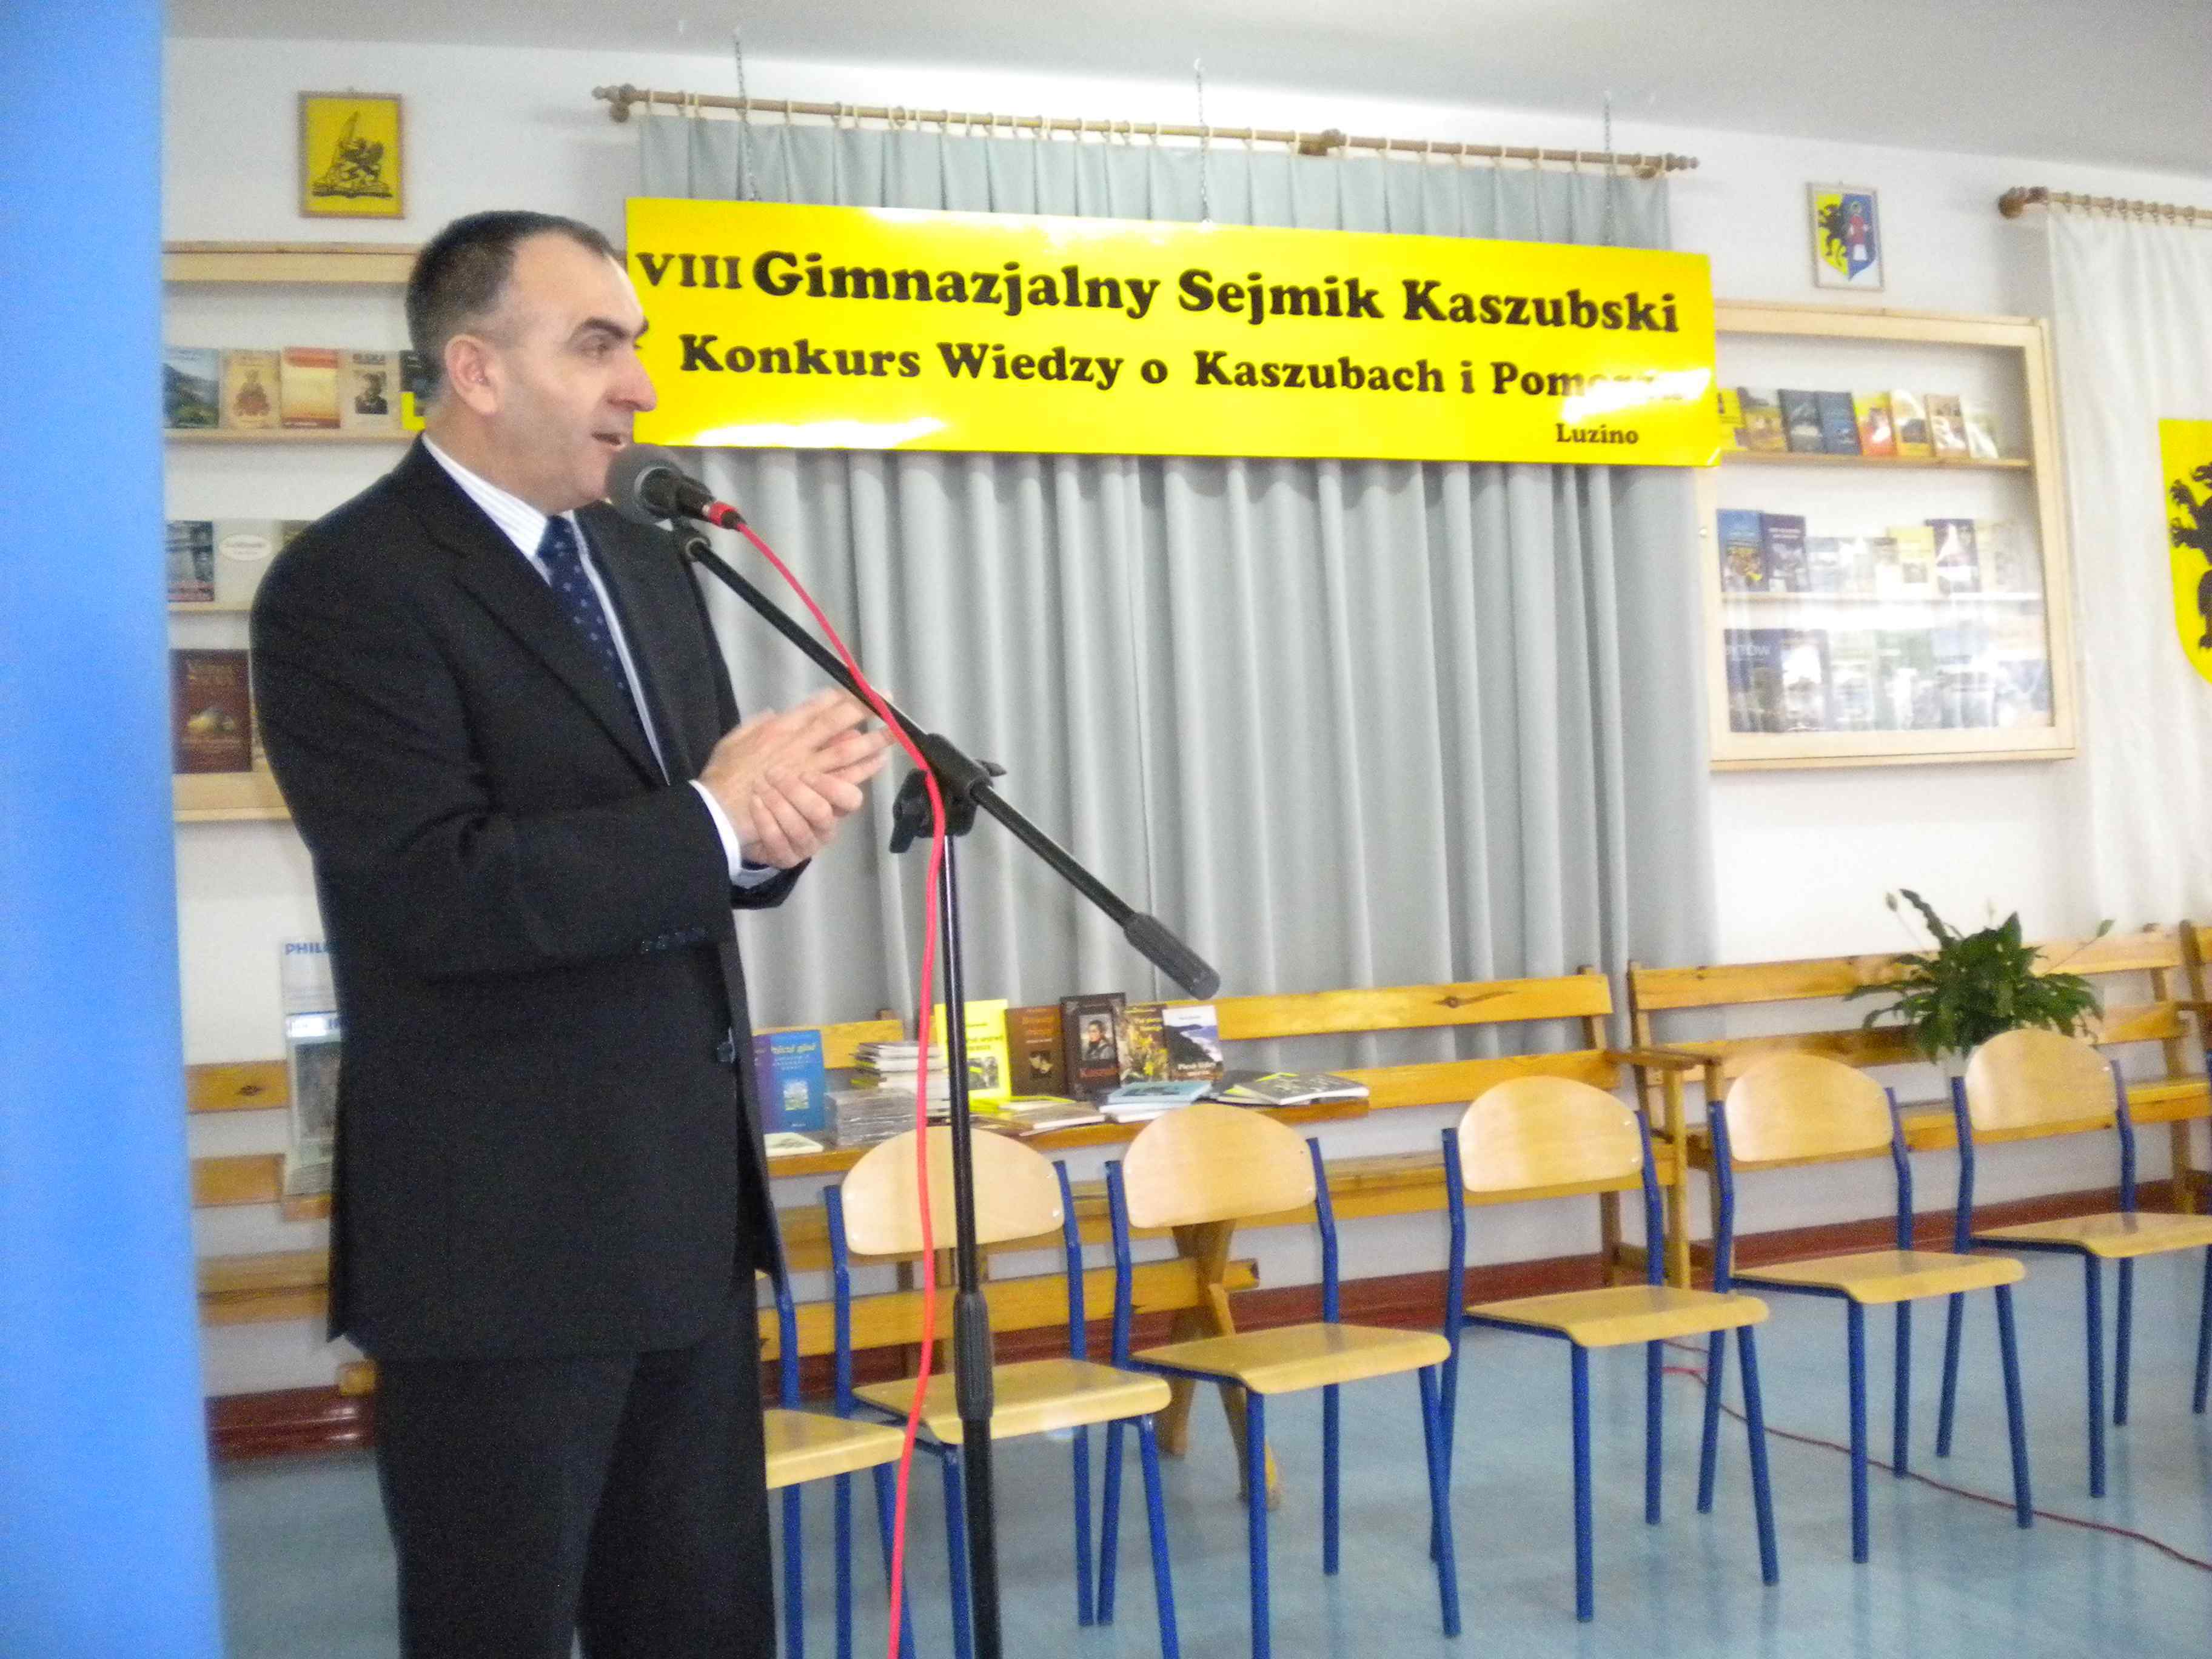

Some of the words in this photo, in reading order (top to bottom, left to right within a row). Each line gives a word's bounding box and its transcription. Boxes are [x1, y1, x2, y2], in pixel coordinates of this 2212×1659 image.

[635, 252, 742, 290] VIII
[753, 250, 1161, 320] Gimnazjalny
[1178, 269, 1385, 326] Sejmik
[1402, 280, 1679, 333] Kaszubski
[679, 333, 920, 377] Konkurs
[937, 342, 1124, 390] Wiedzy
[1141, 359, 1168, 384] o
[1193, 350, 1445, 393] Kaszubach
[1461, 361, 1475, 394] i
[1555, 423, 1640, 444] Luzino
[285, 943, 327, 955] PHIL
